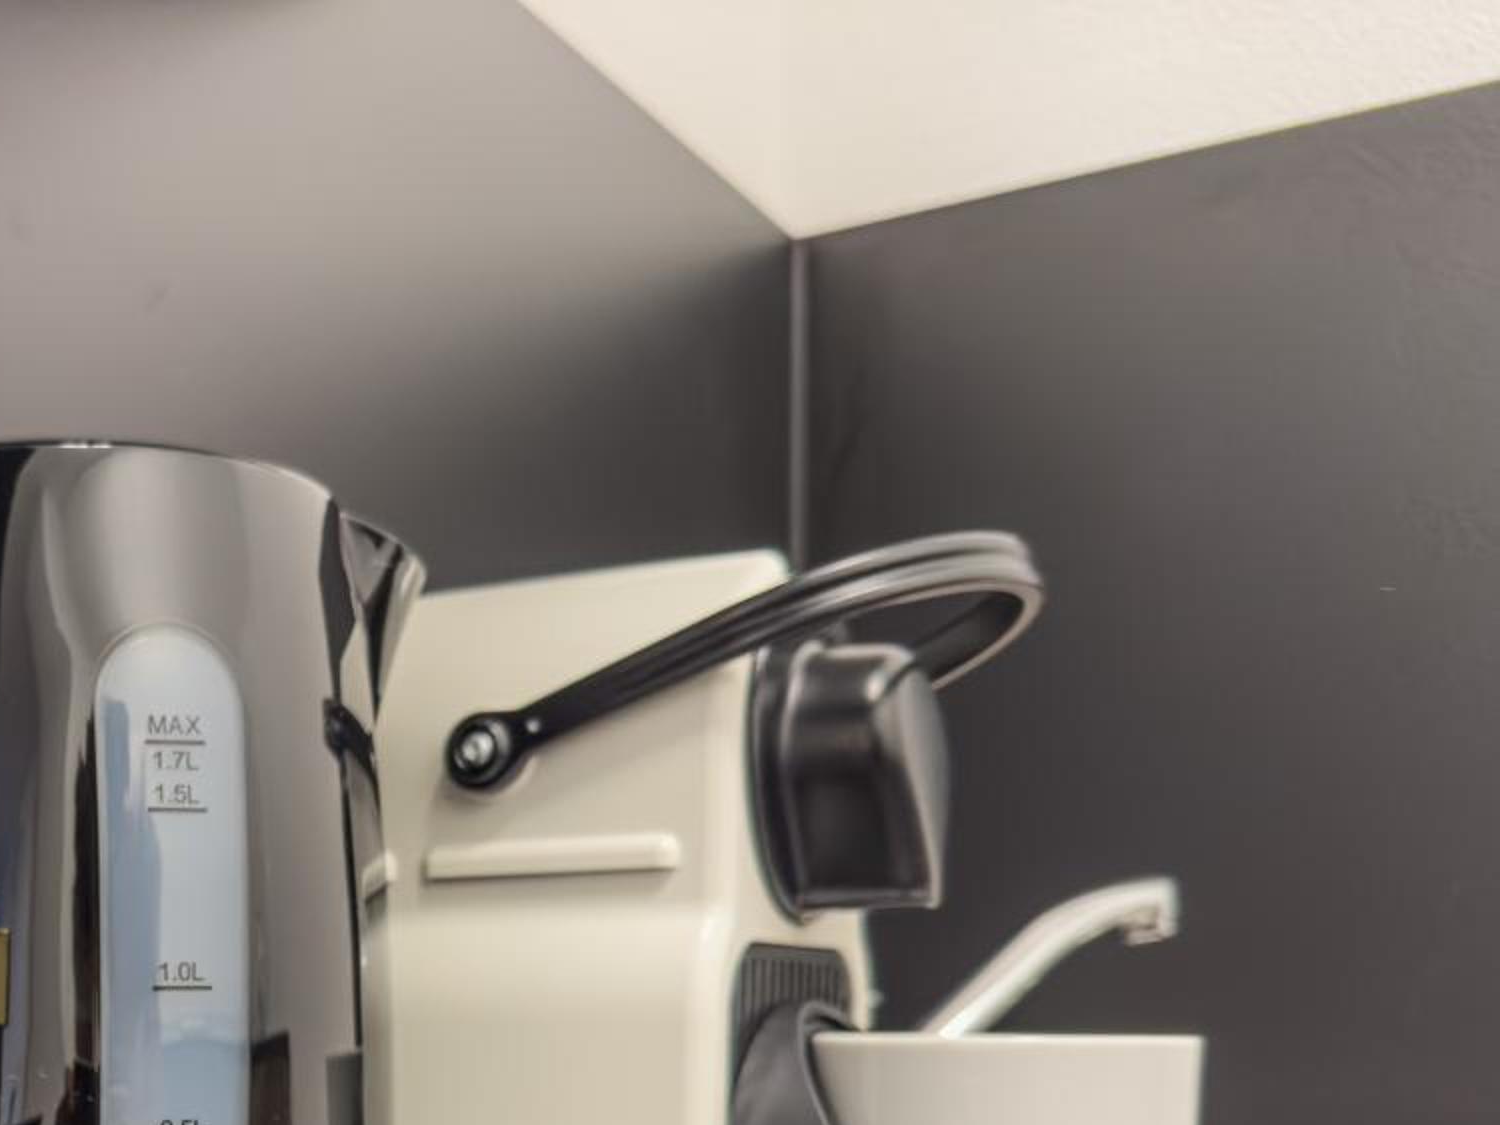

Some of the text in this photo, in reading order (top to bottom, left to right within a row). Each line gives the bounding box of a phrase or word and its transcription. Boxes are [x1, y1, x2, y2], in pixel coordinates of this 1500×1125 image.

[147, 714, 202, 735] MAX
[153, 752, 200, 771] 1.7L
[155, 783, 201, 805] 1.5L
[159, 962, 206, 982] 1.0L
